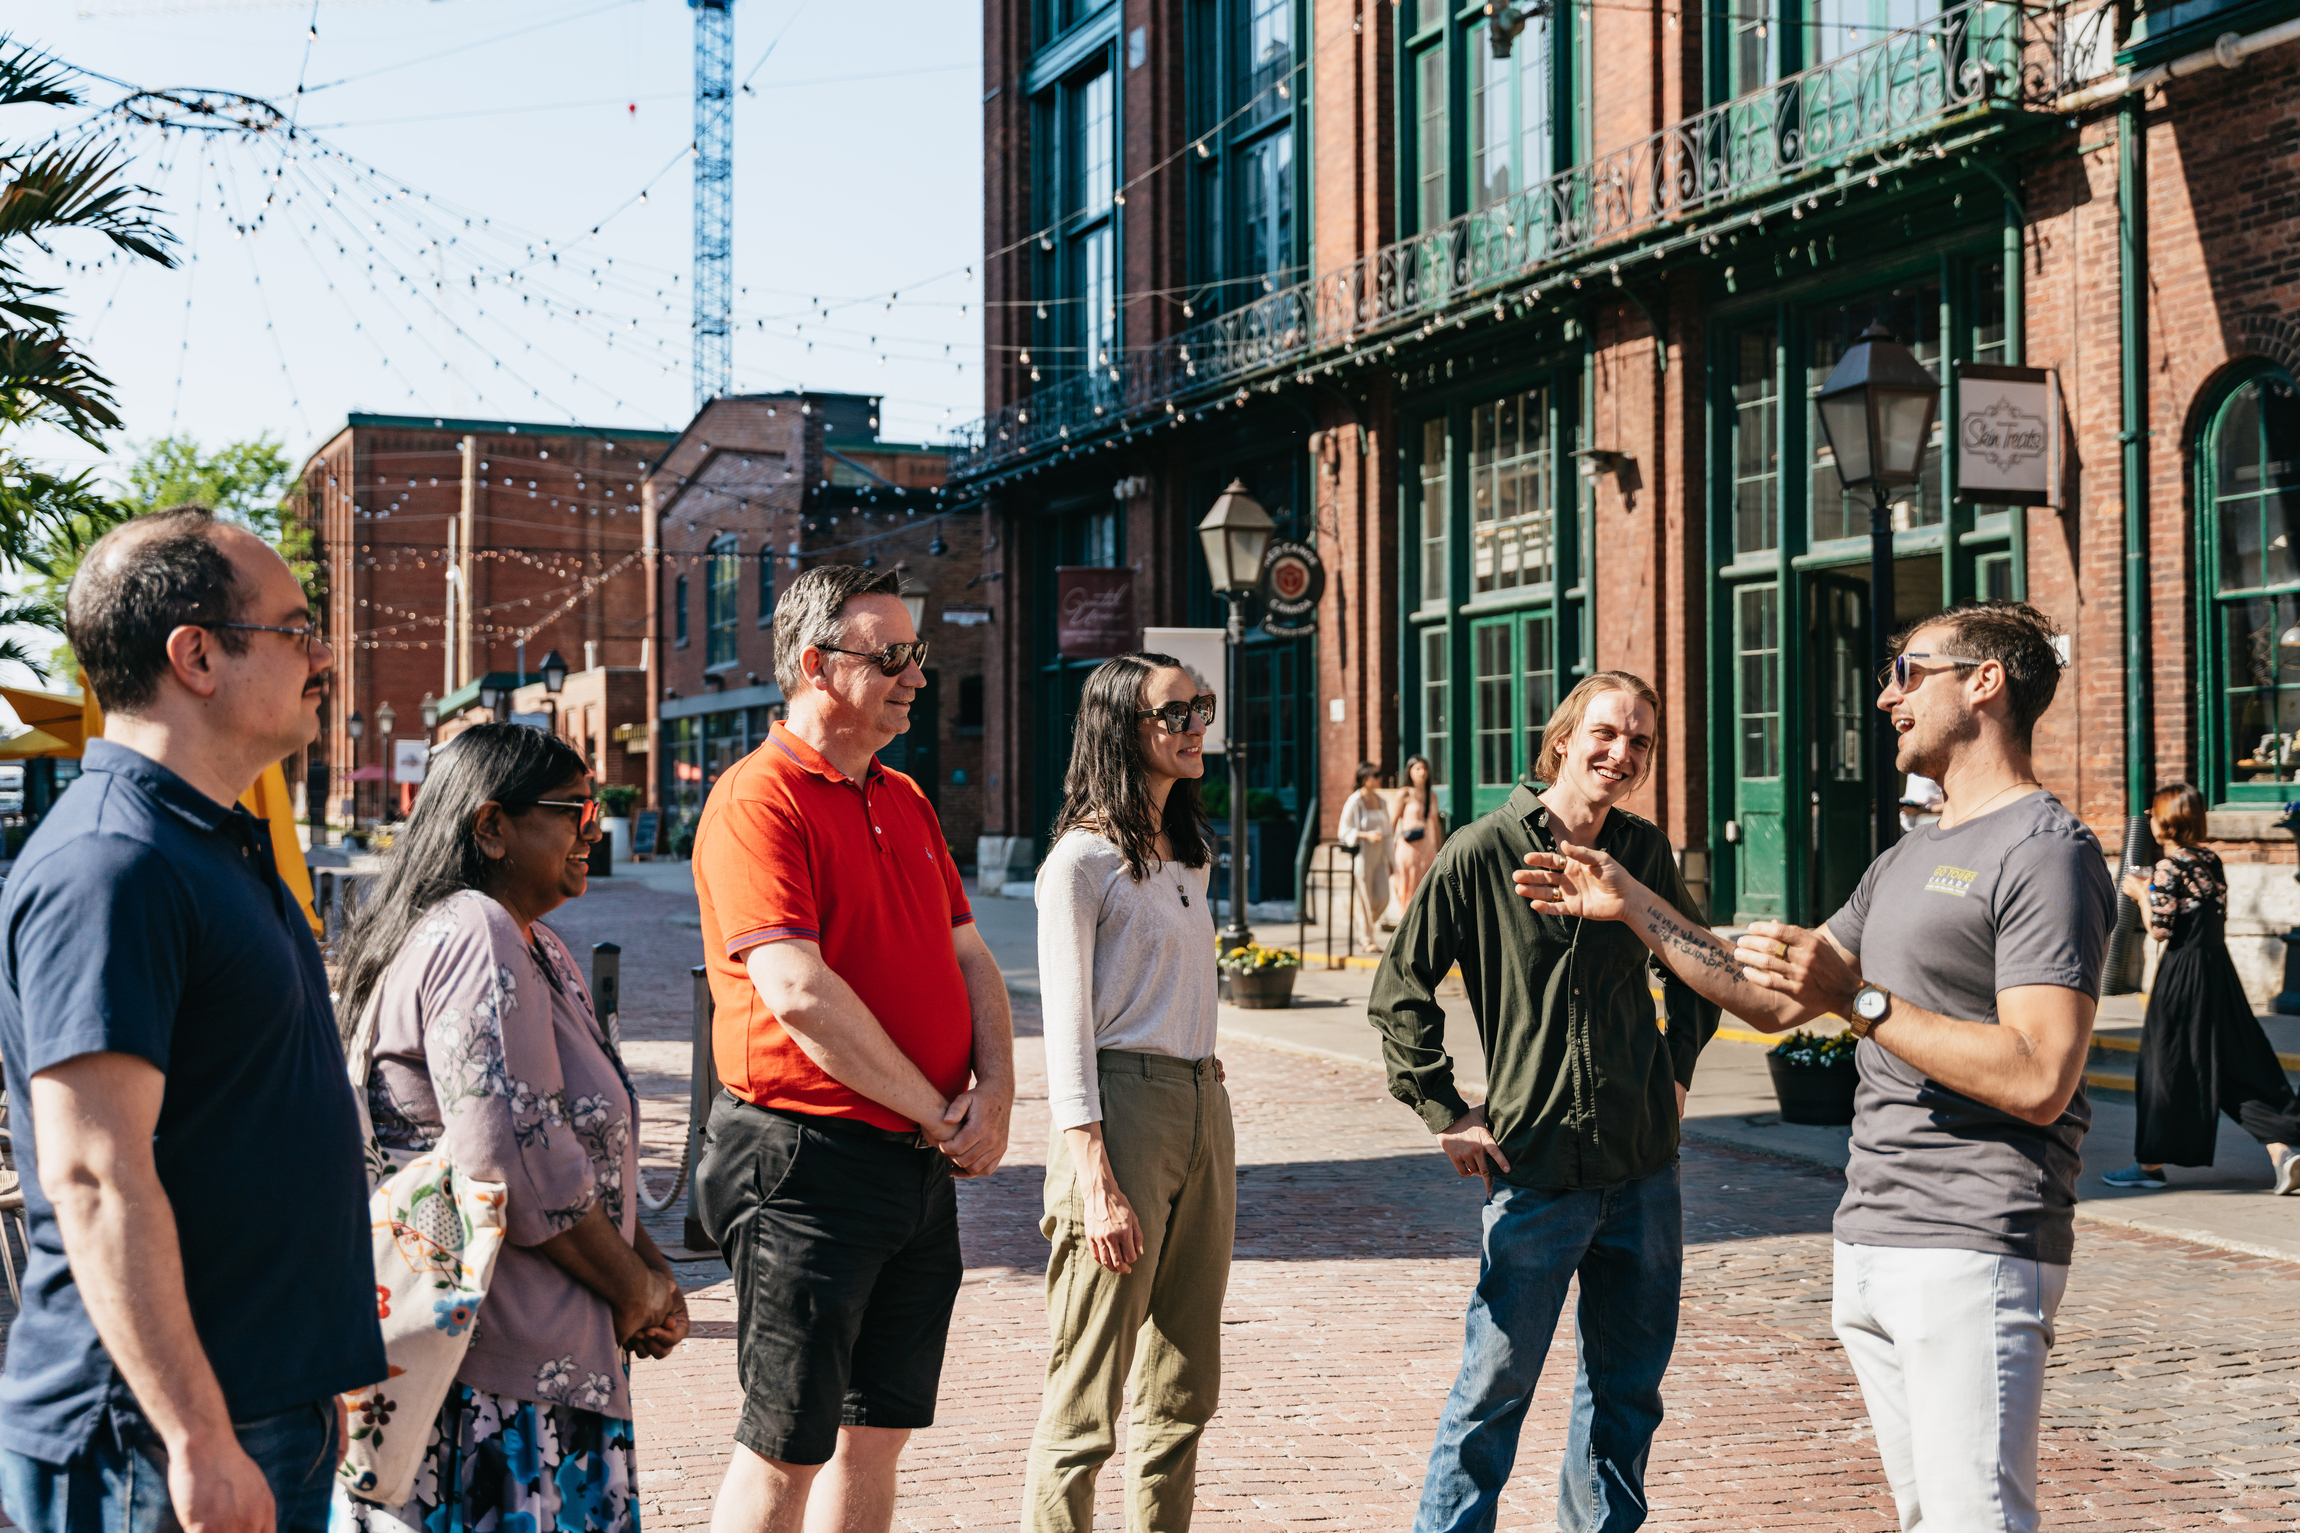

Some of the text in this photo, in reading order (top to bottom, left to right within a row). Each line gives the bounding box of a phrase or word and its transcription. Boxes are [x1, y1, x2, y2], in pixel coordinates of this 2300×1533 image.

[1965, 418, 2041, 449] Skin Treats
[1282, 542, 1318, 567] CANOE
[1269, 598, 1313, 614] CANADA
[1928, 876, 1970, 889] CANADA
[1933, 868, 1976, 883] GO TOURS
